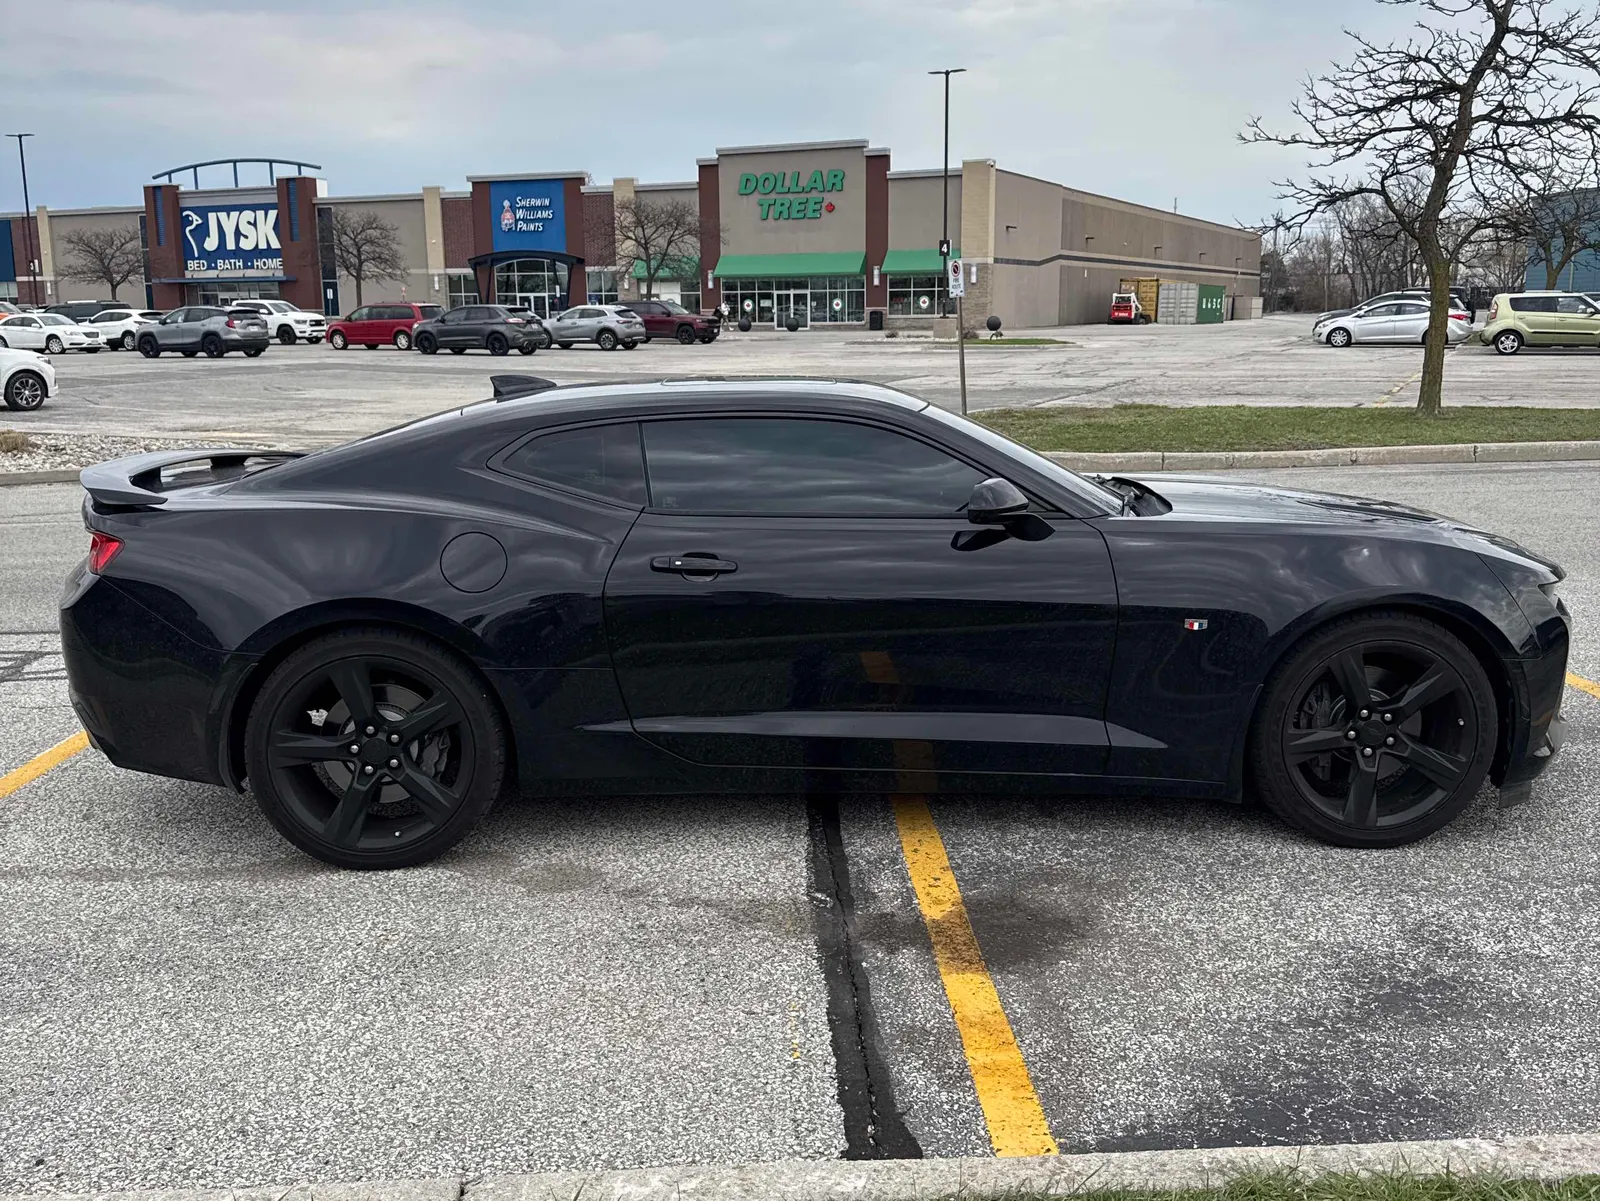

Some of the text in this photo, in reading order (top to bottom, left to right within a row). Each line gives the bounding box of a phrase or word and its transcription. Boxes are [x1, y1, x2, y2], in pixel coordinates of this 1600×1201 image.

[738, 169, 845, 195] DOLLAR
[758, 197, 824, 220] TREE
[203, 210, 281, 251] JYSK
[942, 244, 948, 252] 4
[187, 258, 283, 271] BED BATH HOME
